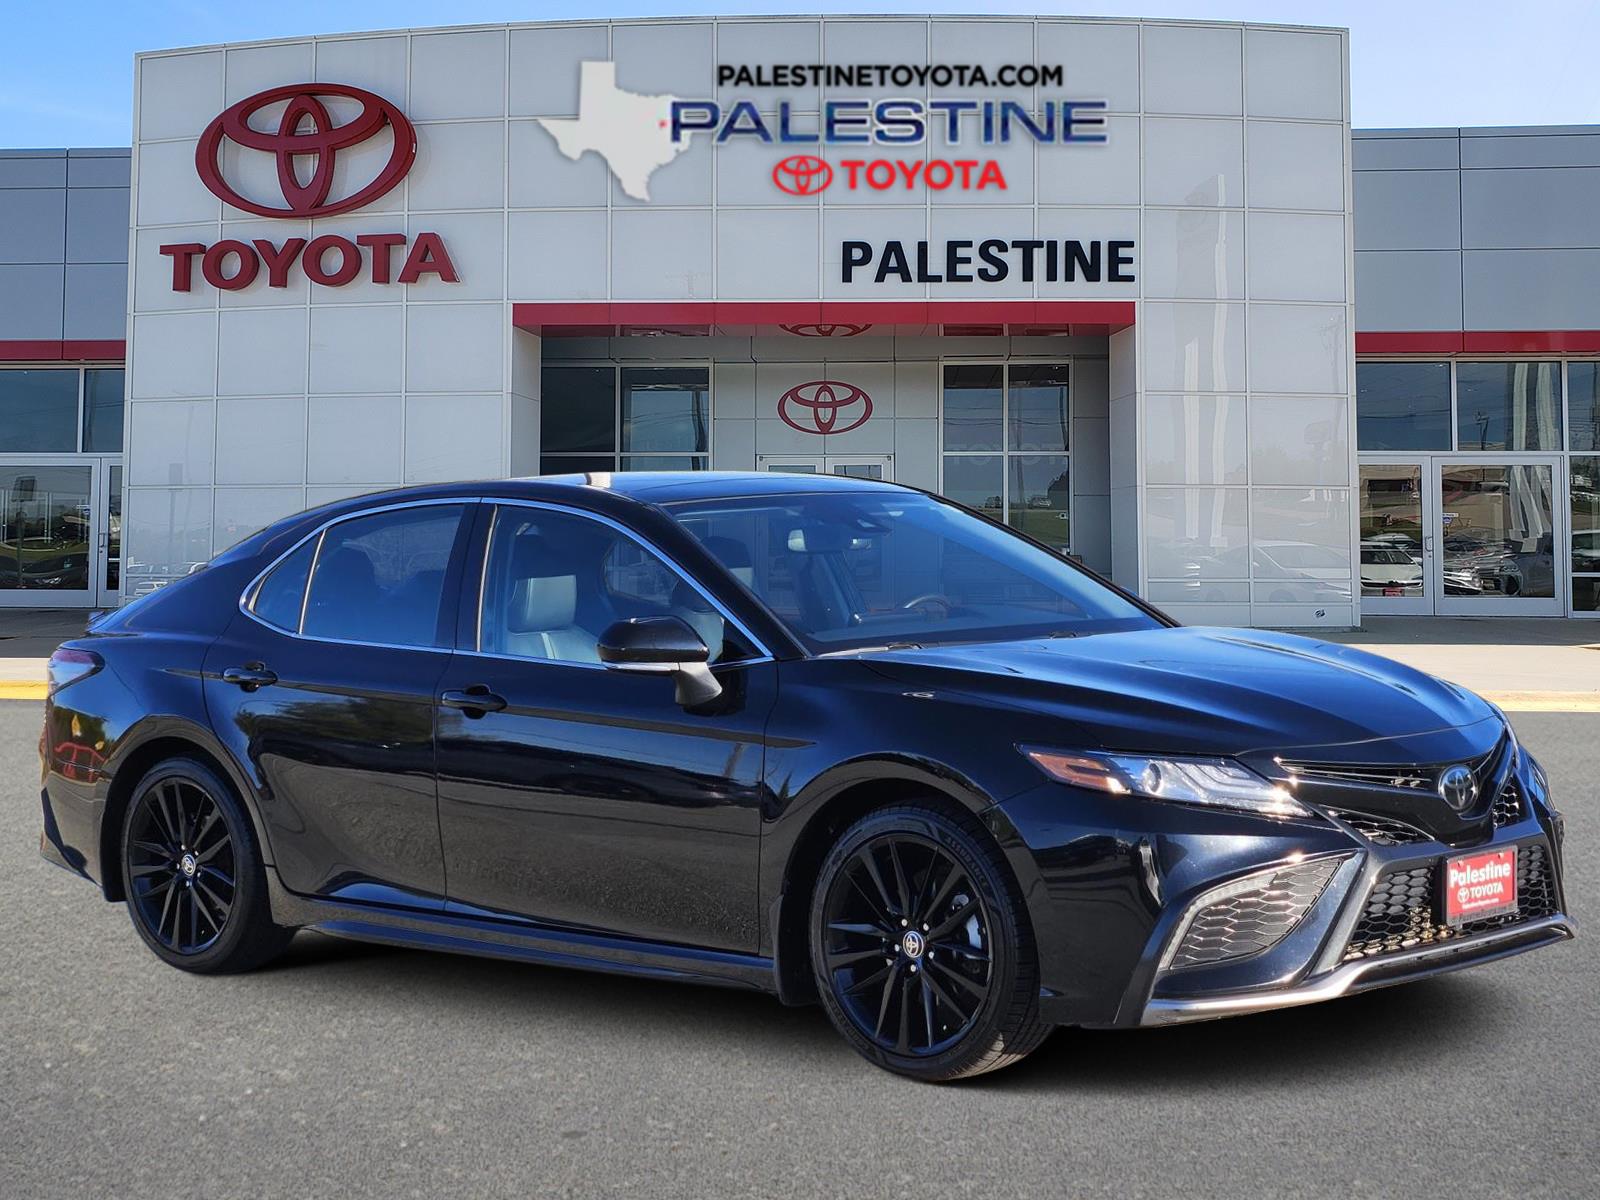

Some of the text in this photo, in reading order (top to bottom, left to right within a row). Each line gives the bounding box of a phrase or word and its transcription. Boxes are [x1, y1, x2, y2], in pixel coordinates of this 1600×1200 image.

[159, 232, 460, 292] TOYOTA
[841, 240, 1136, 284] PALESTINE
[1449, 861, 1511, 888] Palestine
[1470, 882, 1504, 899] TOYOTA
